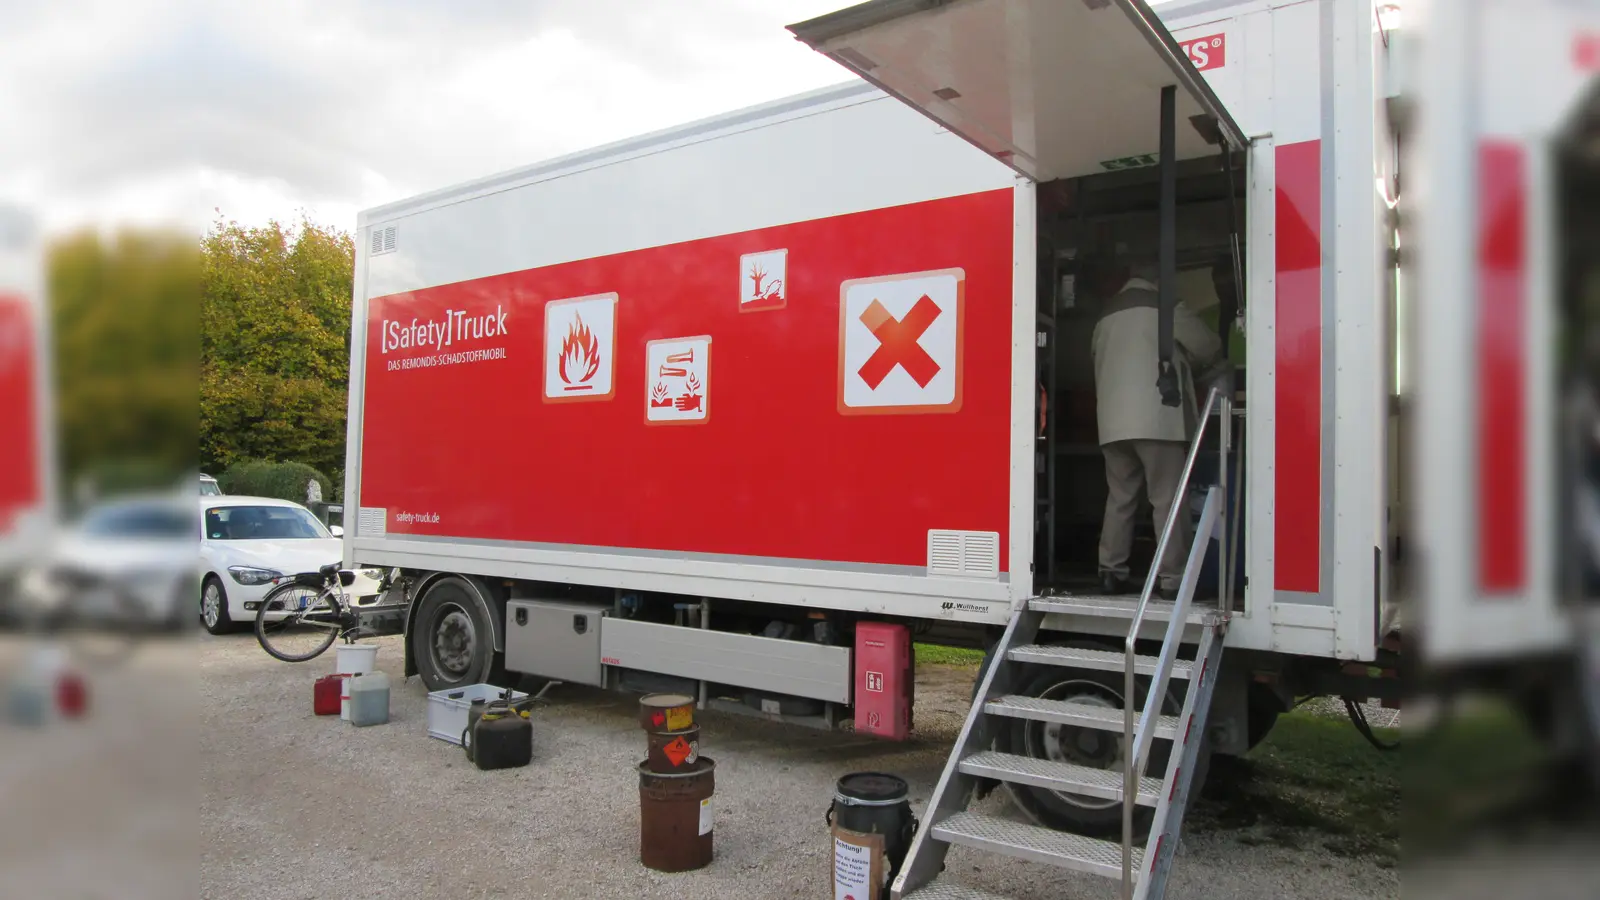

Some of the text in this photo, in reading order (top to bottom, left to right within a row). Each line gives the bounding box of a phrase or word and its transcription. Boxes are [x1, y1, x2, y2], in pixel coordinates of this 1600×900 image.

[381, 304, 508, 354] [Safety]Truck
[387, 347, 507, 371] DAS REMONDIS-SCHADSTOFFMOBIL
[396, 510, 440, 525] safety-truck.de
[836, 839, 862, 854] Achtung!
